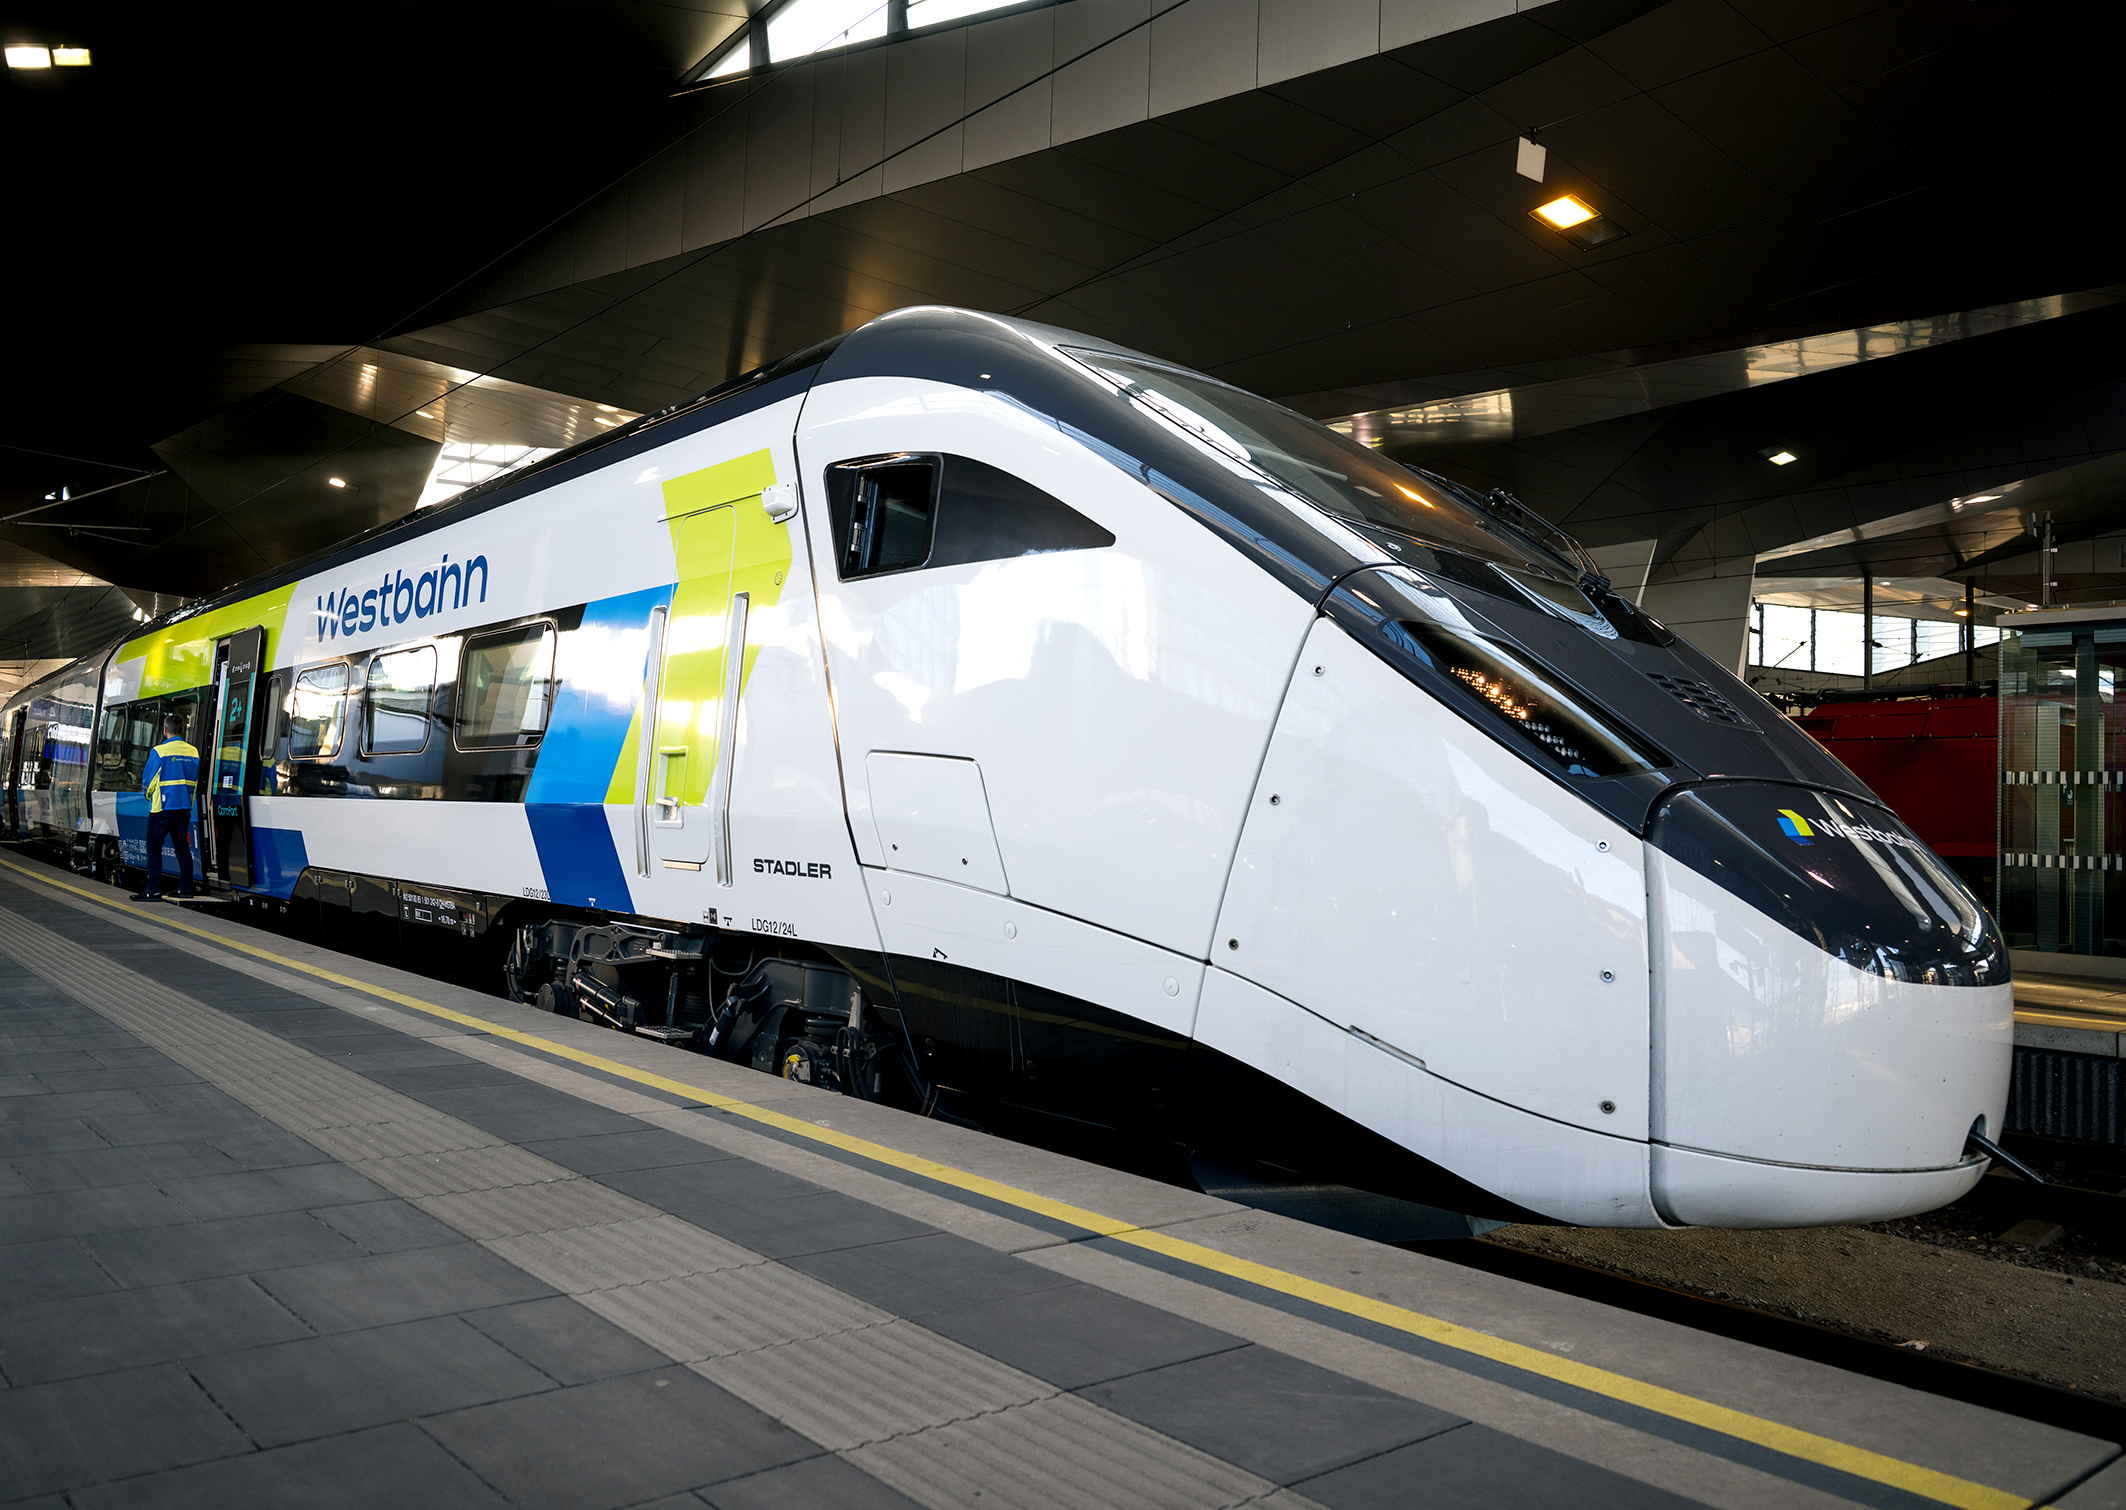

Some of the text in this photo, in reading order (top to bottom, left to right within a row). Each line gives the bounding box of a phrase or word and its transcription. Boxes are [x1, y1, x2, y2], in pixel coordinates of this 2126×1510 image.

[317, 553, 489, 643] Westbahn
[230, 697, 243, 722] 2+
[217, 804, 239, 817] Comfort
[1807, 817, 1929, 855] Westbahn
[753, 858, 832, 879] STADLER
[751, 918, 798, 936] LDG12/24L
